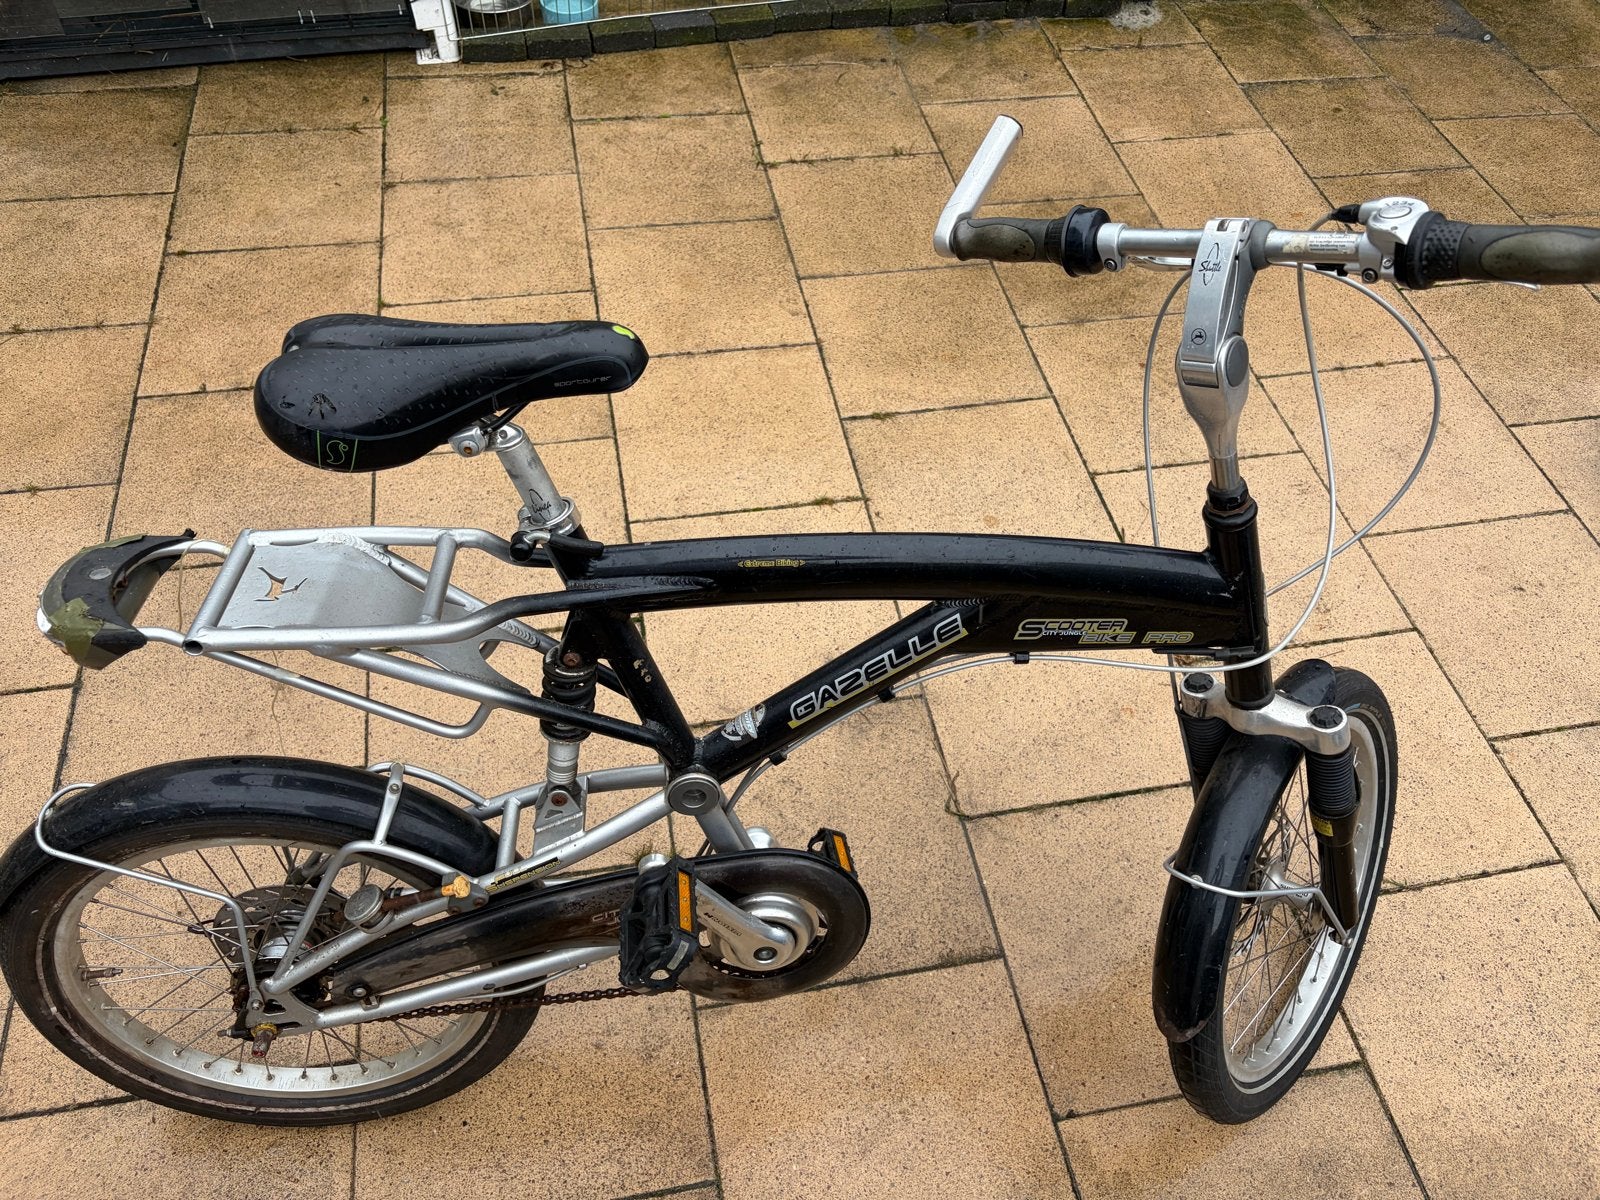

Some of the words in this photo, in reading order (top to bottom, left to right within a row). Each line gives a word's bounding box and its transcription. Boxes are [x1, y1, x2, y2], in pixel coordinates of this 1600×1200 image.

[1013, 618, 1128, 641] SCOOTER
[1078, 632, 1137, 644] BIKE
[1141, 632, 1194, 644] PRO
[790, 613, 963, 722] GAZELLE
